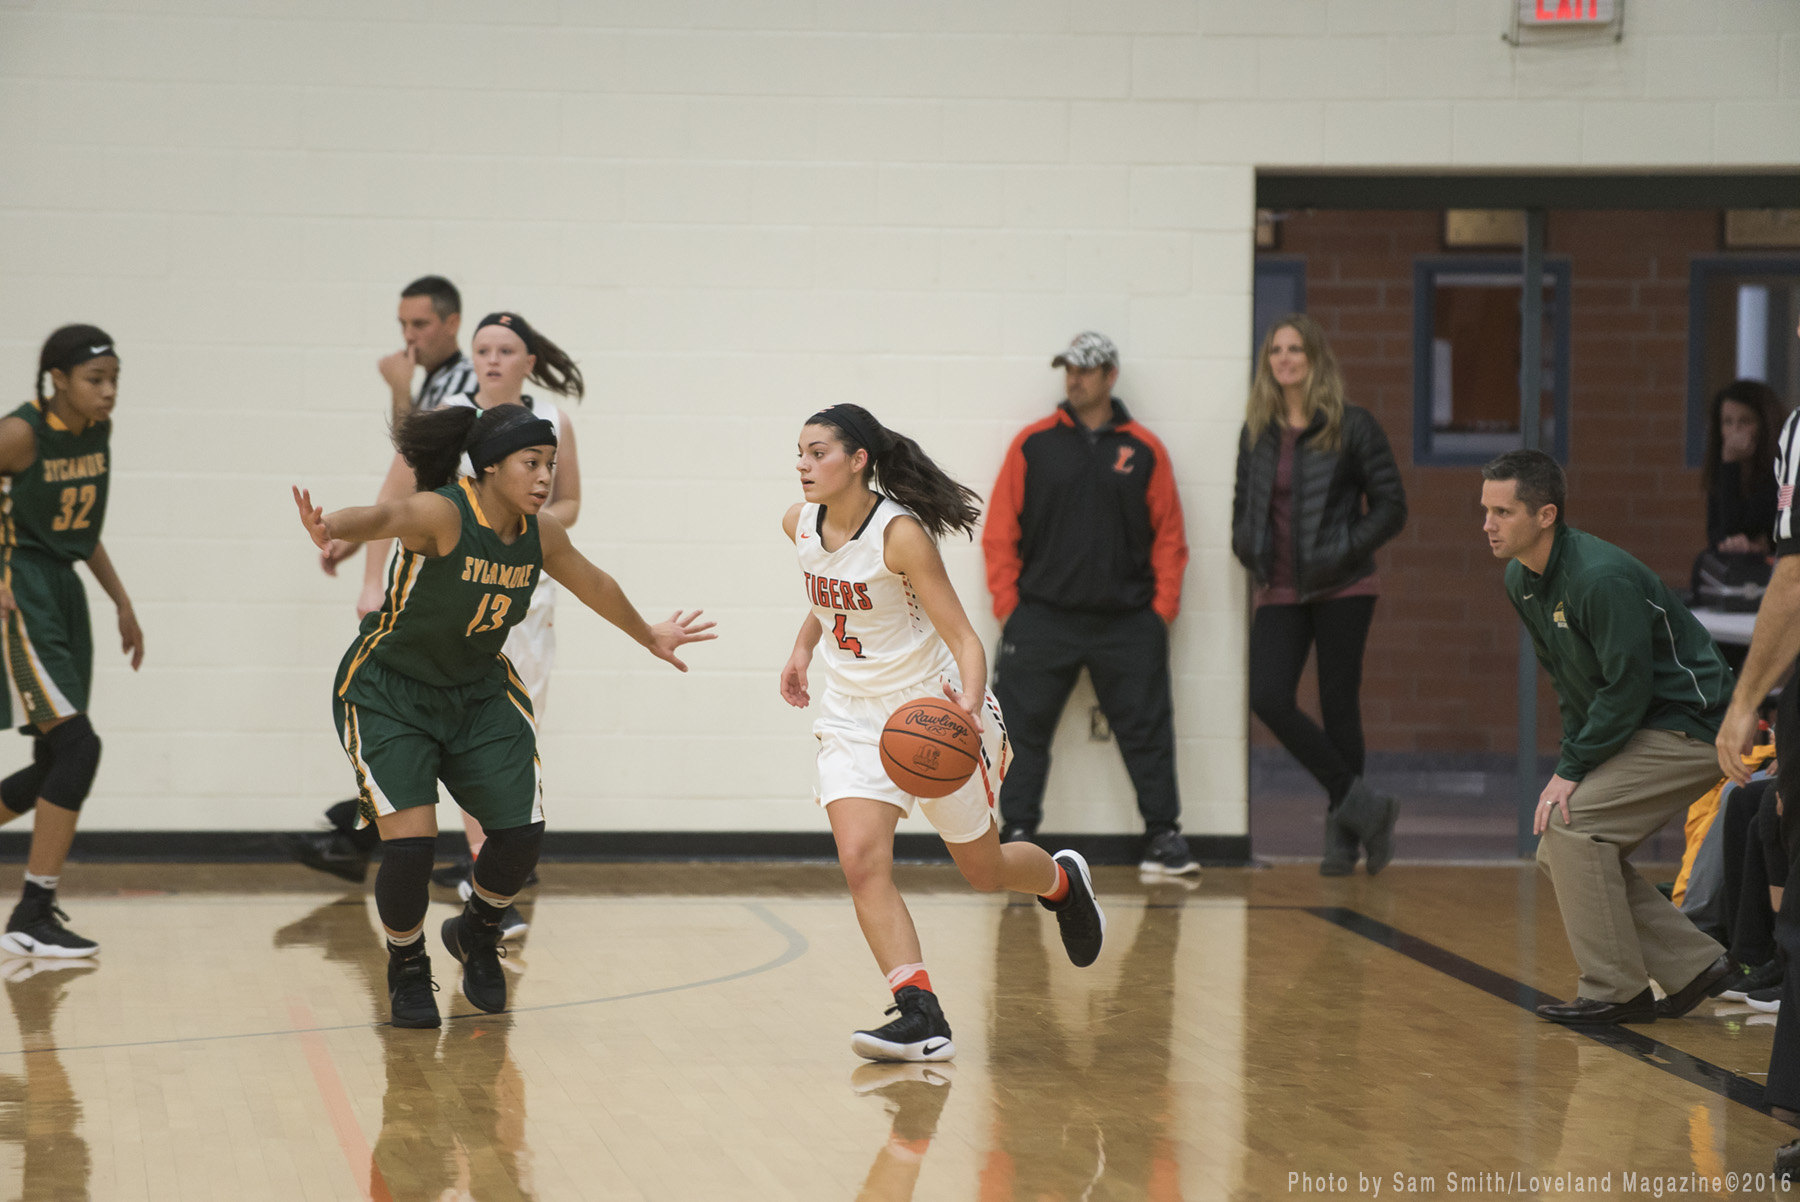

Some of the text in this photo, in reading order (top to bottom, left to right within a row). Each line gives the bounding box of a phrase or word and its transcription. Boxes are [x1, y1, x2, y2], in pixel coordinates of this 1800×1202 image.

[43, 452, 106, 482] SYCAMOR
[52, 485, 97, 531] 32
[461, 556, 534, 589] SYCAMORE
[804, 571, 873, 610] TIGERS
[465, 593, 512, 637] 13
[832, 613, 866, 658] 4
[905, 709, 968, 738] Rawlings
